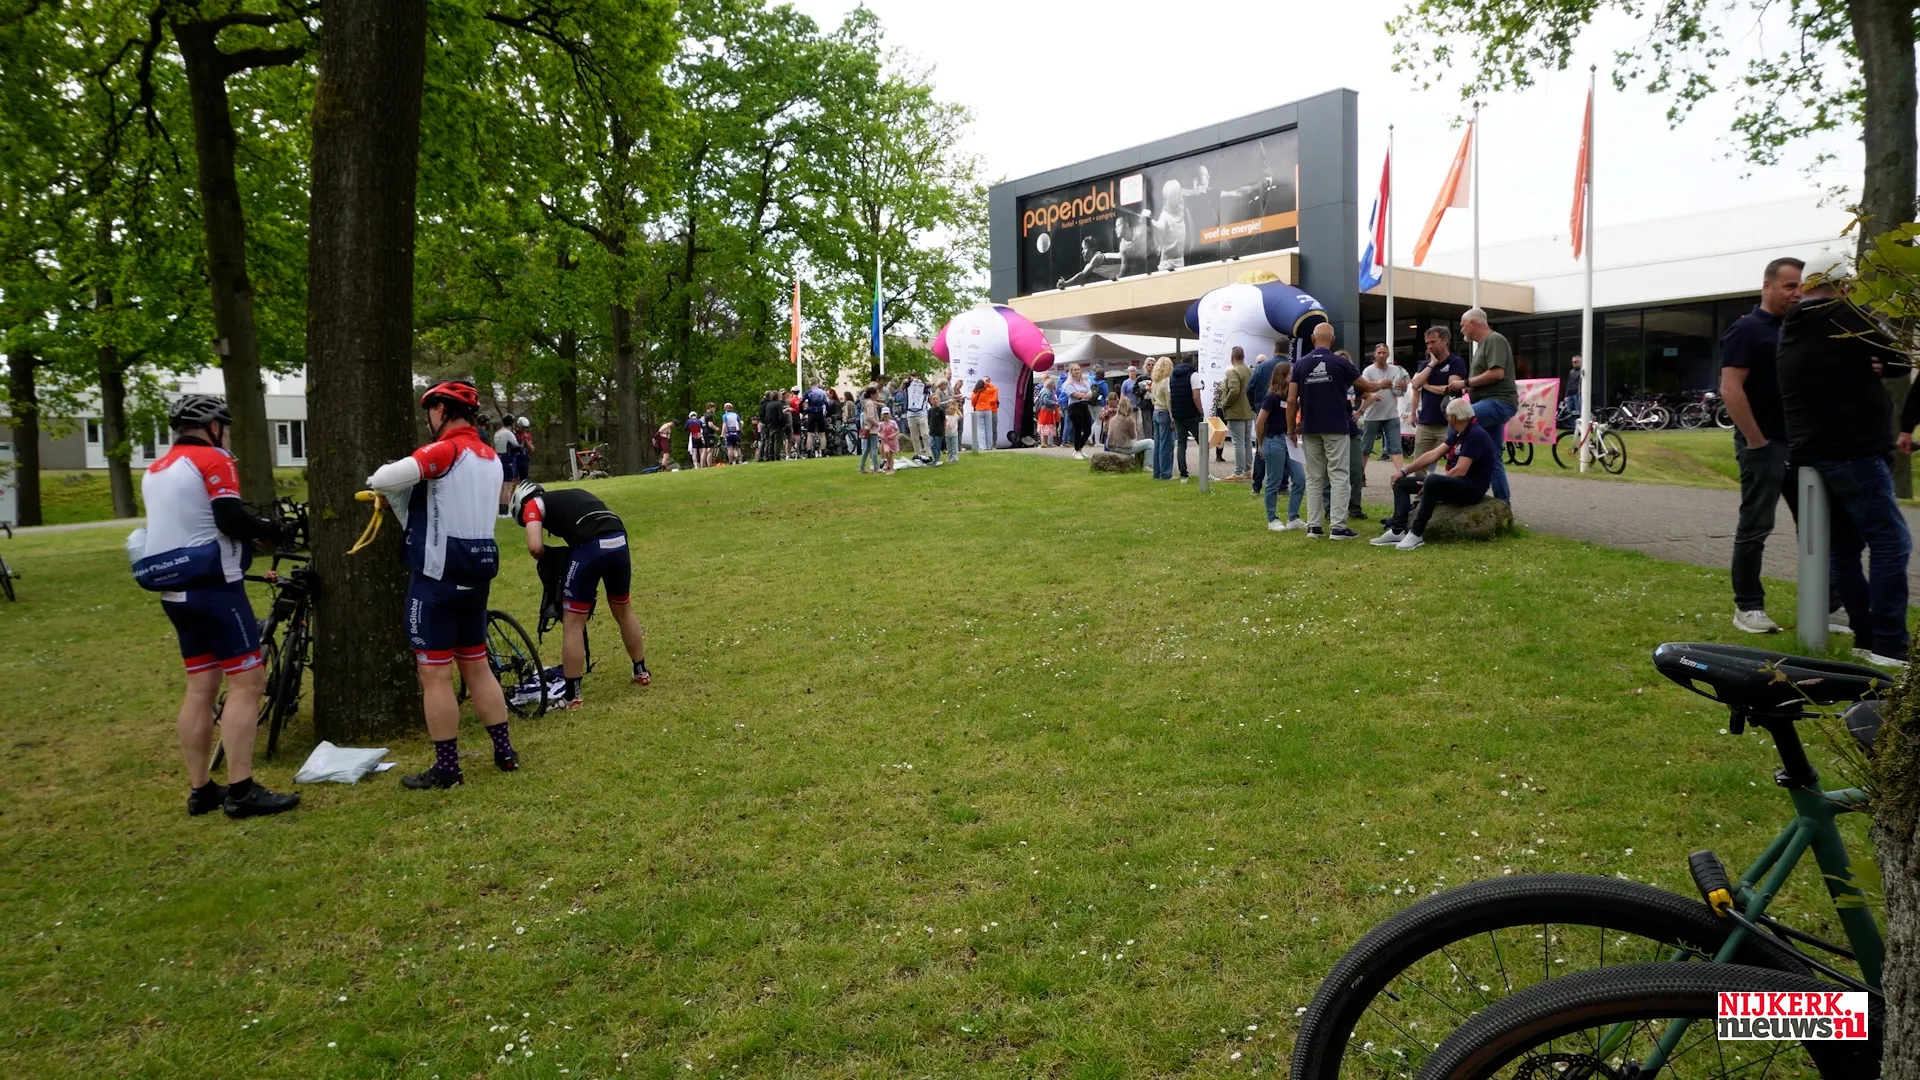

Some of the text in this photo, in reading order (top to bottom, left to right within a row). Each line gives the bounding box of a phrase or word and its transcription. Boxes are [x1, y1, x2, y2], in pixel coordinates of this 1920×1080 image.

[1023, 180, 1116, 237] papendal
[1061, 212, 1116, 229] hotel sport congres
[1204, 220, 1261, 239] voel de energie!
[410, 598, 419, 634] BeGlobal
